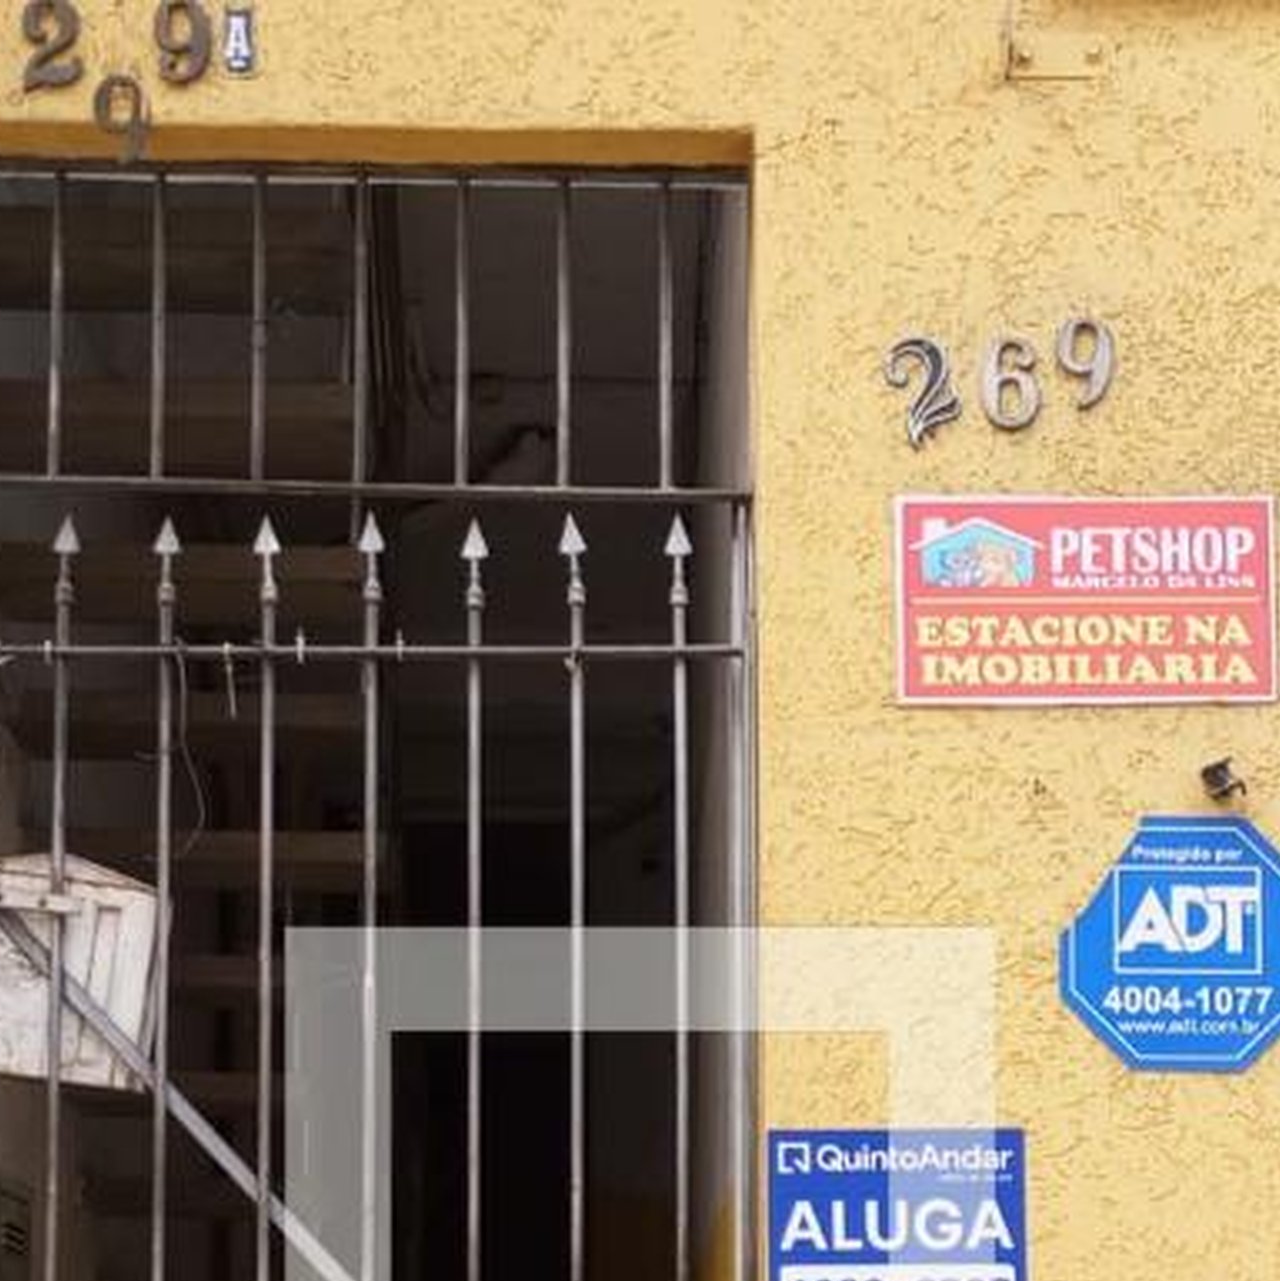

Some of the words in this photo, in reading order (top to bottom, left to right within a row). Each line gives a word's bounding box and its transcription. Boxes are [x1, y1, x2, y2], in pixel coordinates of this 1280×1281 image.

[886, 316, 1115, 452] 269
[1050, 526, 1256, 575] PETSHOP
[915, 614, 1173, 648] ESTACIONE
[1186, 613, 1252, 647] NA
[922, 651, 1258, 686] IMOBILIARIA
[1120, 885, 1260, 954] ADT
[1103, 985, 1274, 1015] 4004-1077
[817, 1143, 1015, 1173] QuintoAndar
[780, 1198, 1016, 1252] ALUGA
